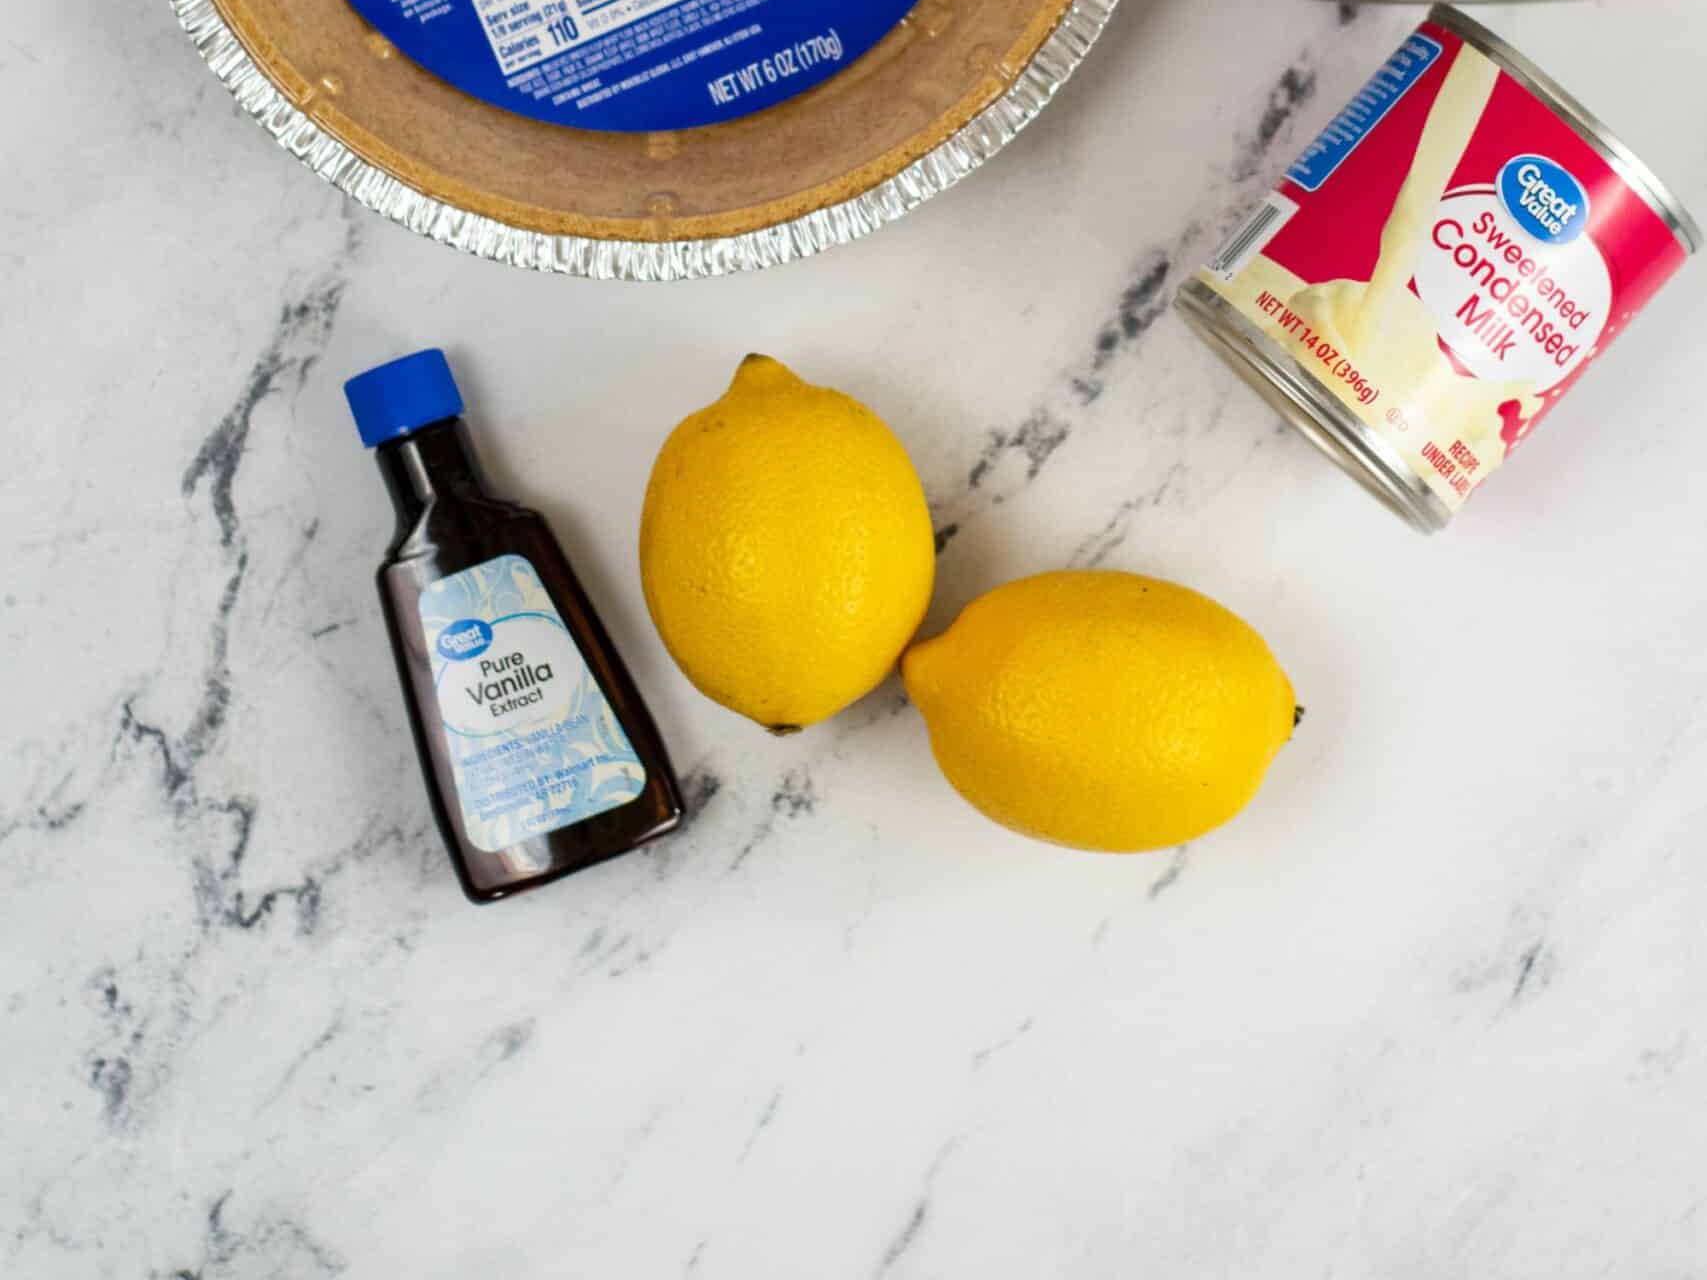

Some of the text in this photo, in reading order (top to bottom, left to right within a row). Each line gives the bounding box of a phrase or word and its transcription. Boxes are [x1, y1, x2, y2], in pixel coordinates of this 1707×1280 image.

[498, 32, 540, 59] Calories
[546, 15, 580, 47] 110
[507, 9, 542, 33] serving
[707, 73, 740, 106] NET
[736, 62, 764, 93] WT
[762, 58, 777, 83] 6
[774, 48, 800, 77] OZ
[794, 27, 844, 71] (170g)
[1518, 164, 1577, 225] Great
[1520, 190, 1562, 236] Value
[1432, 218, 1580, 367] Condensed
[1473, 211, 1591, 330] Sweetened
[1256, 290, 1381, 405] NET WT 14 OZ (396g)
[1455, 293, 1516, 361] Milk
[1420, 441, 1456, 481] UNDER
[1448, 439, 1481, 476] RECIPE
[440, 623, 482, 651] Great
[465, 663, 553, 706] Vanilla
[480, 652, 524, 678] Pure
[489, 687, 544, 718] Extract
